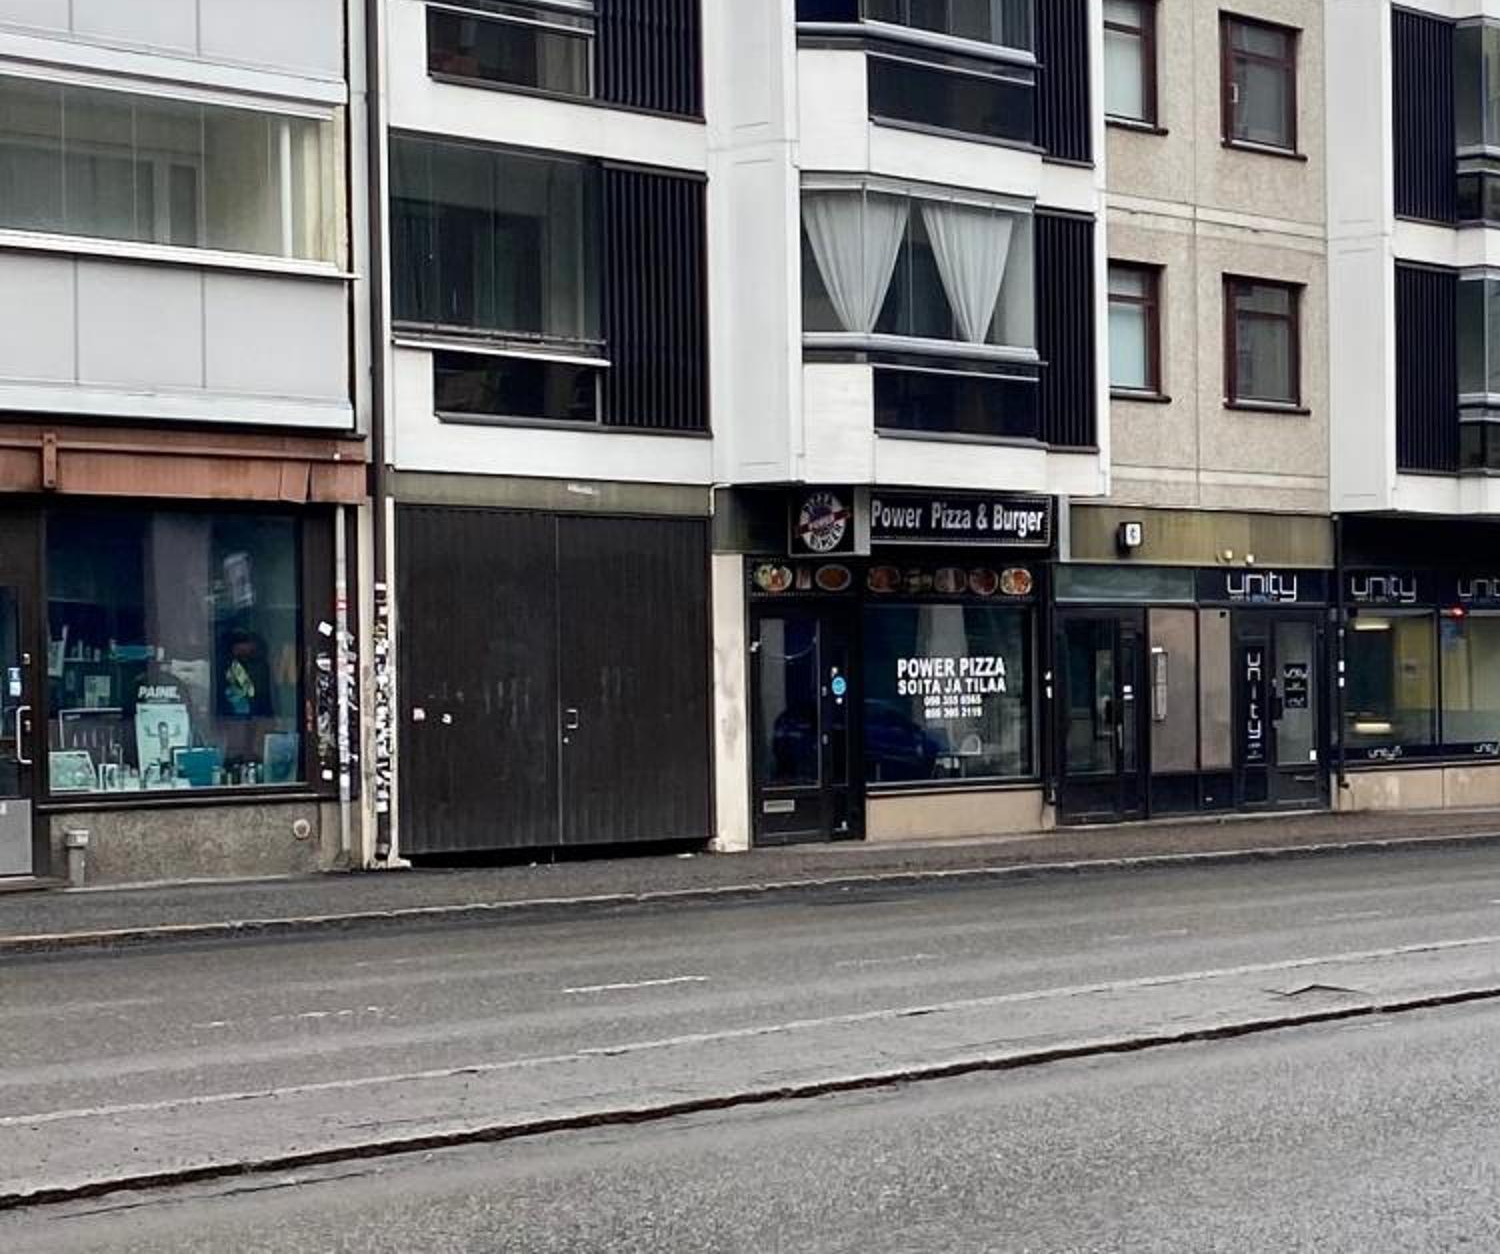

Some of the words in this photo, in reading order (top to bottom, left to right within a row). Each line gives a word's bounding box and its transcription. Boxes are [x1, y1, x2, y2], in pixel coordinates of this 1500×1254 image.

[871, 499, 922, 529] Power
[931, 501, 972, 529] Pizza
[976, 503, 989, 530] &
[992, 504, 1044, 538] Burger
[1227, 571, 1298, 603] unity
[1351, 574, 1417, 604] unity
[897, 657, 956, 678] POWER
[959, 657, 1005, 677] PIZZA
[897, 679, 942, 695] SOITA
[944, 678, 962, 694] JA
[965, 677, 1007, 693] TILAA
